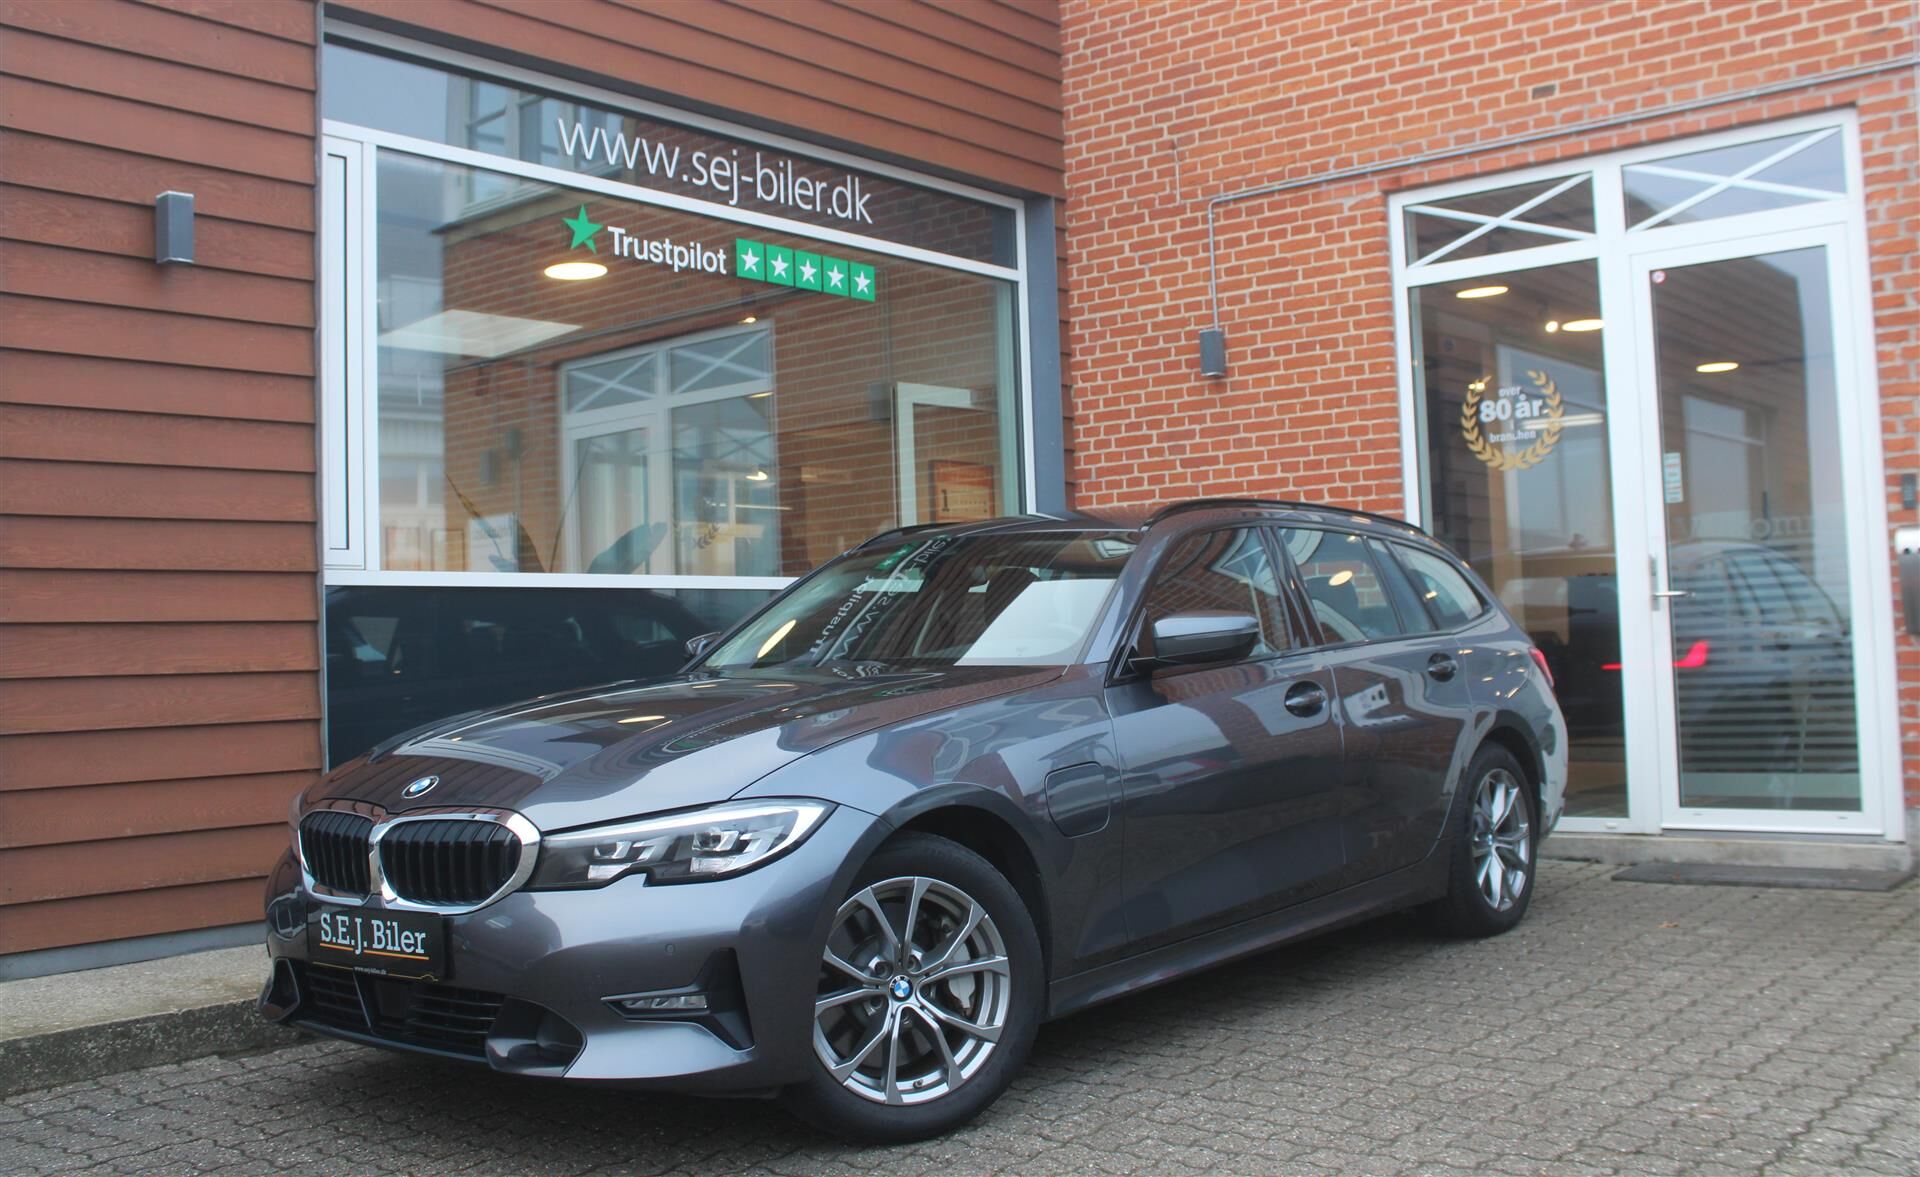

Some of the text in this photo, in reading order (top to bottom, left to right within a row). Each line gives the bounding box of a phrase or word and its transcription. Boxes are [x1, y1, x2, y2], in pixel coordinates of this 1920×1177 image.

[557, 118, 874, 225] www.sej-biler.dk
[607, 225, 727, 275] Trustpilot
[1479, 393, 1543, 423] 80 år
[320, 912, 426, 955] S.E.J. Biler
